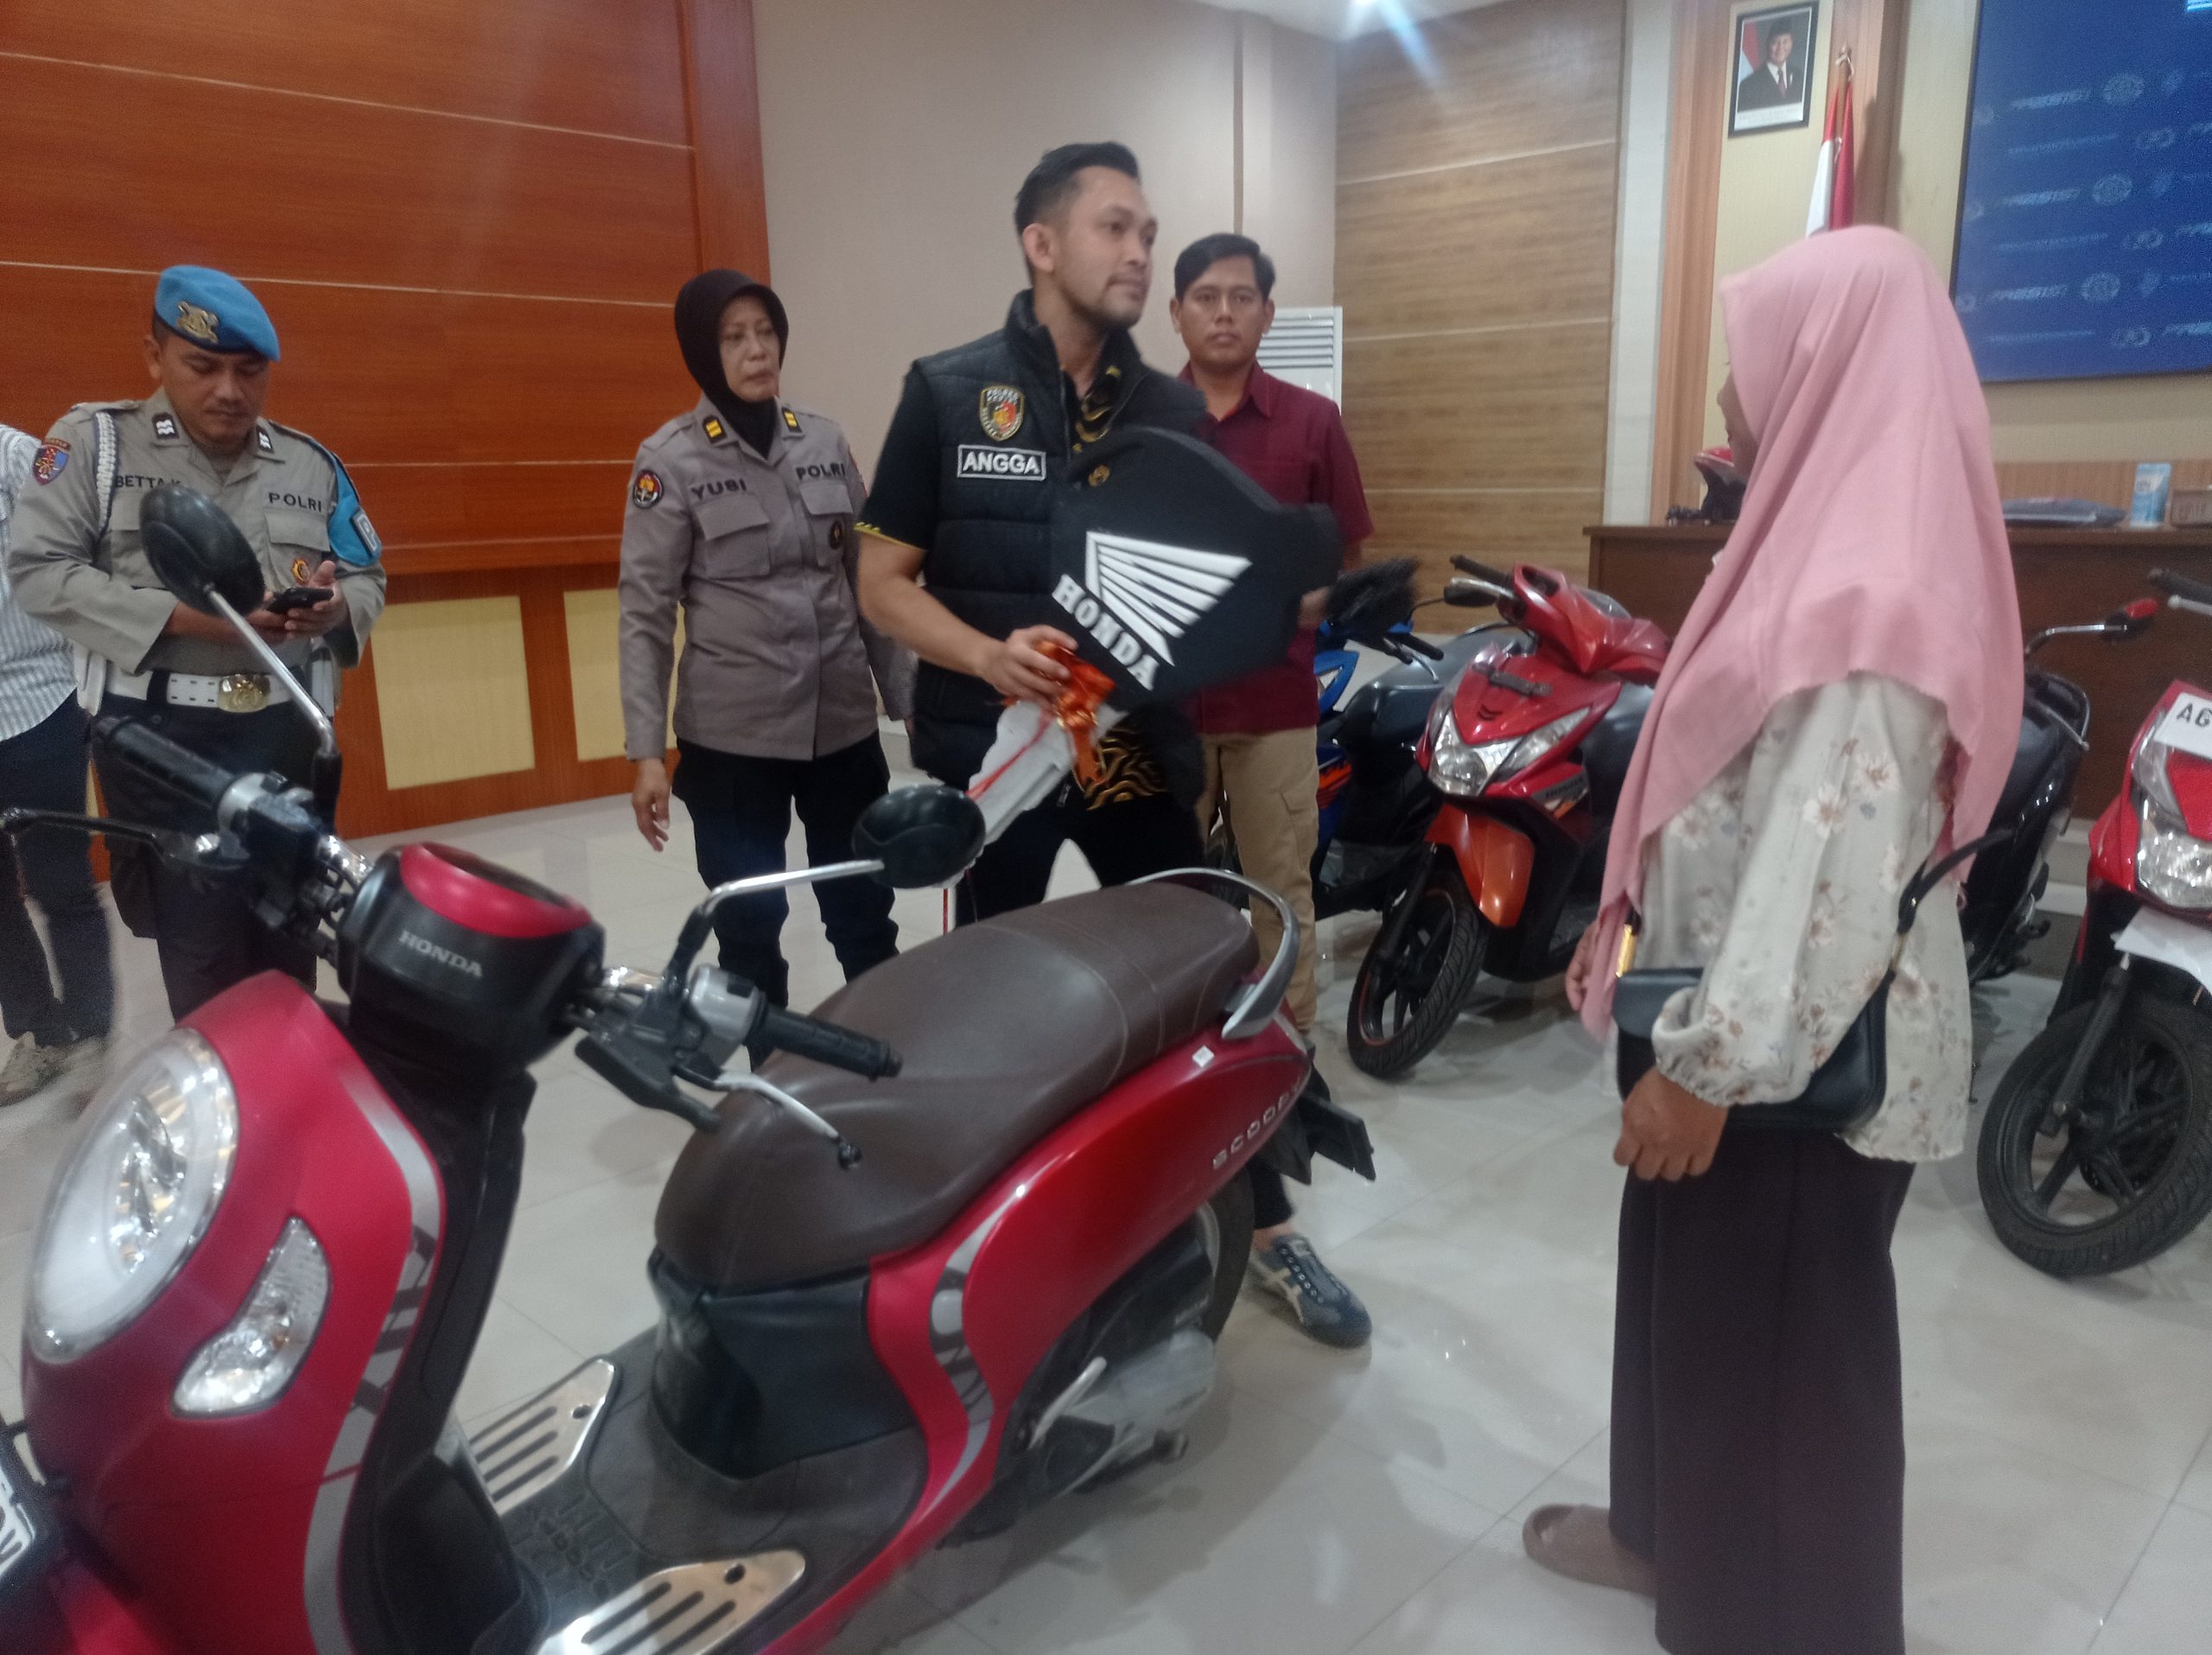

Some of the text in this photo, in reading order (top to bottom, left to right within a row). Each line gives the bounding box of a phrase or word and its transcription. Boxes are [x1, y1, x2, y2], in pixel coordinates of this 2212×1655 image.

[796, 462, 846, 481] POLRI
[963, 451, 1041, 474] ANGGA
[268, 492, 322, 512] POLRI
[1052, 574, 1160, 691] HONDA
[398, 929, 483, 977] HONDA
